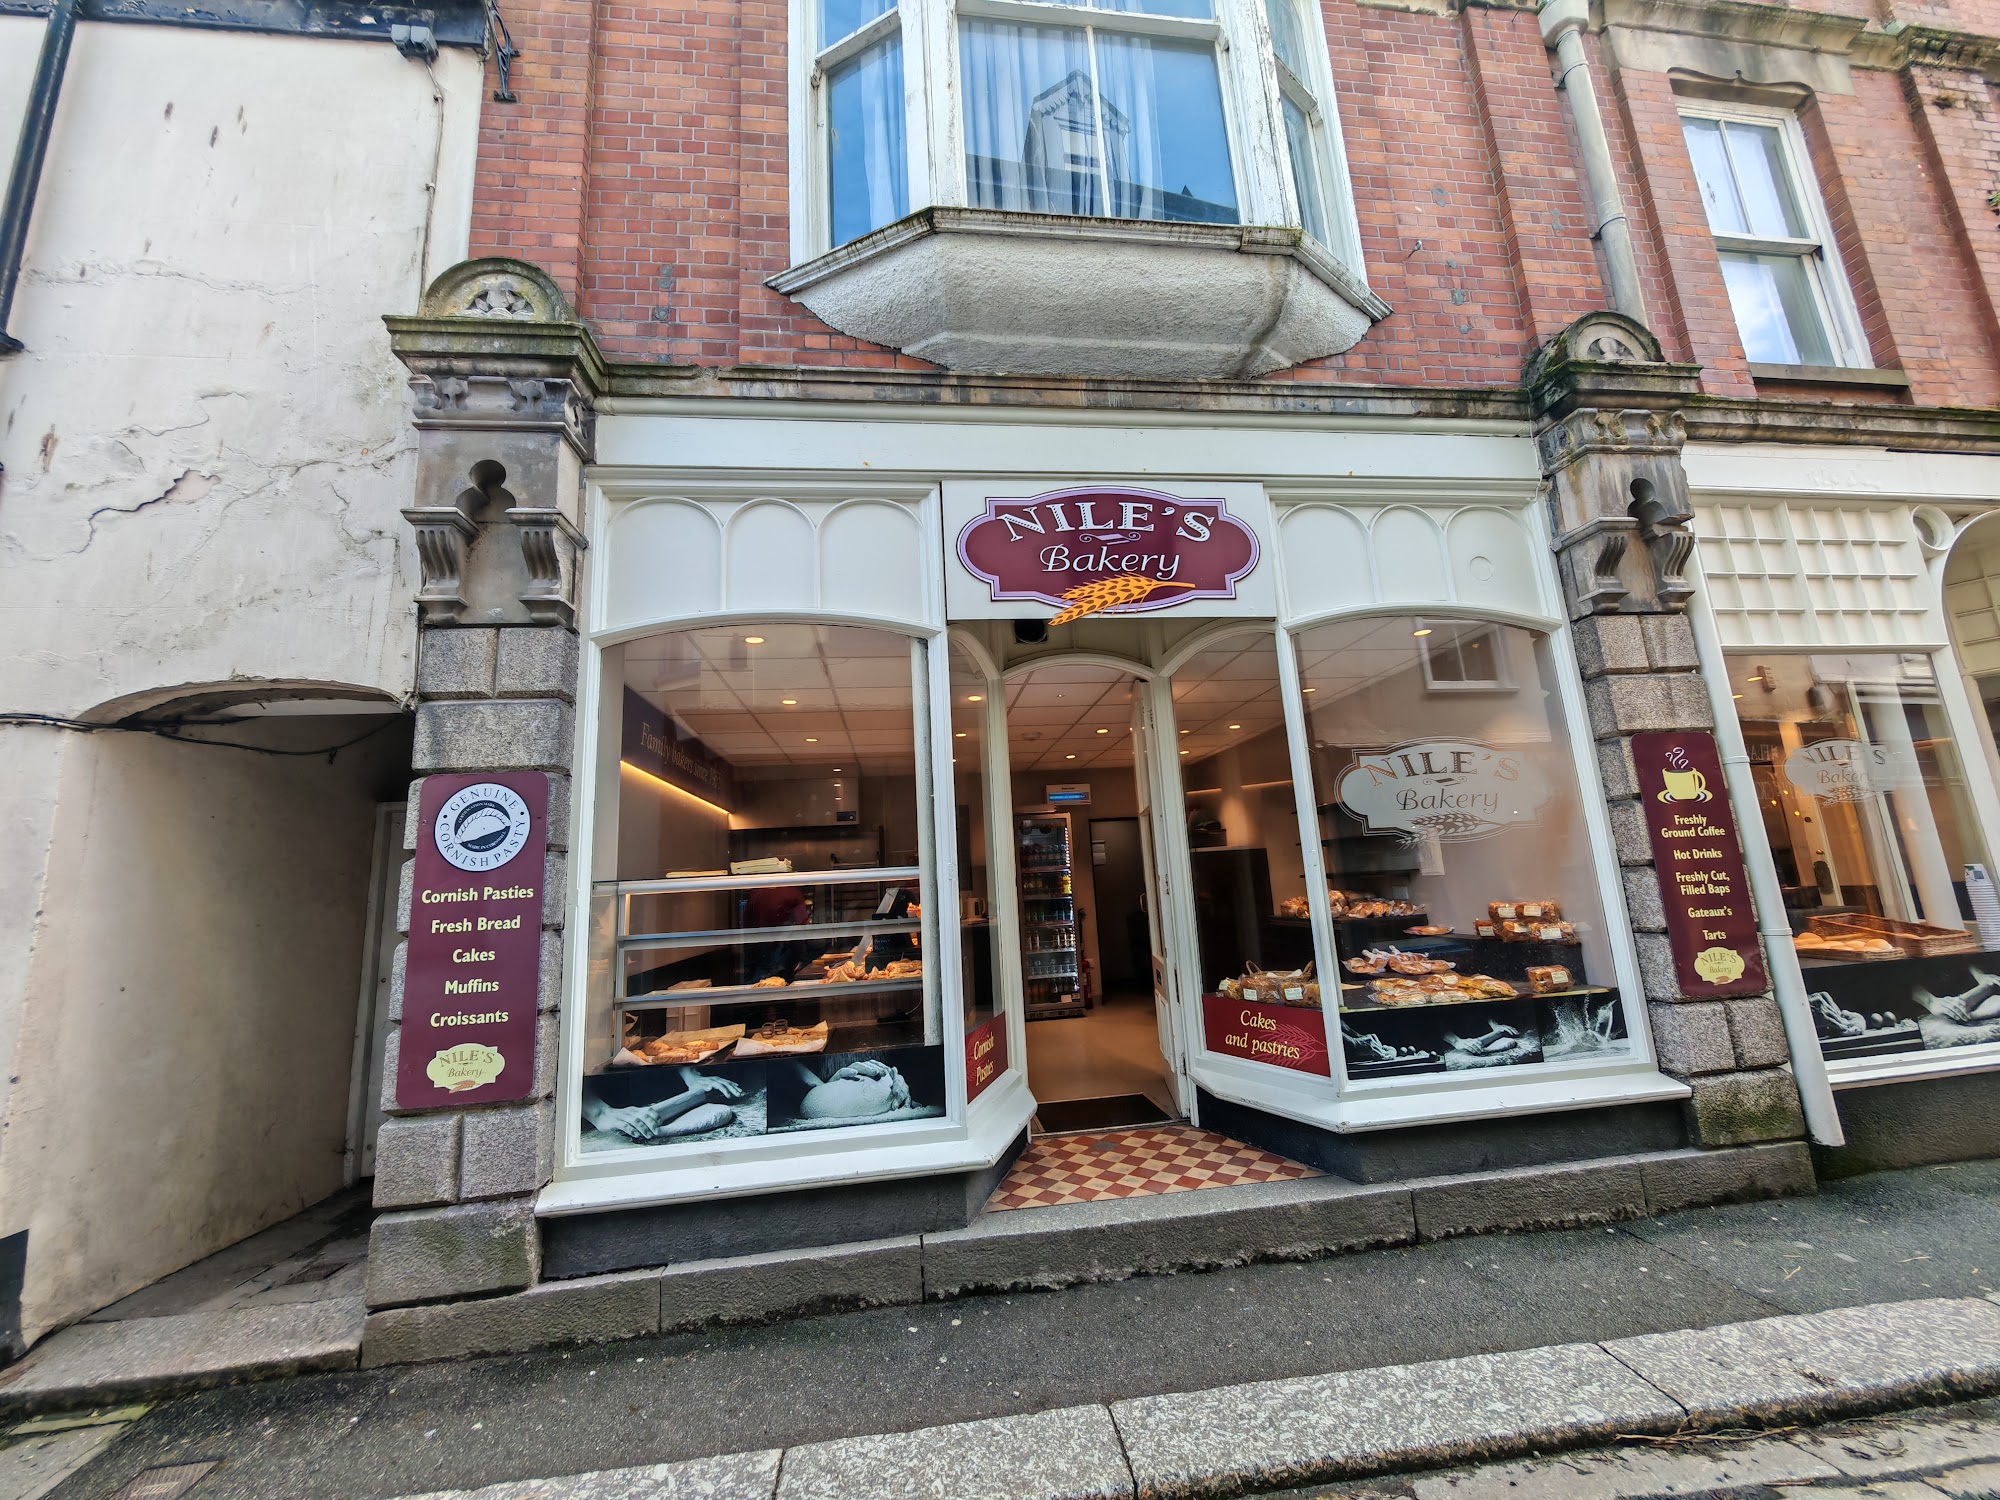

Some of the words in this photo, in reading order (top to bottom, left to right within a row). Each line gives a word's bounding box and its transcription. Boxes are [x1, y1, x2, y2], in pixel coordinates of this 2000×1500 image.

[996, 501, 1215, 543] NILE'S
[1039, 543, 1180, 580] Bakery
[641, 722, 670, 764] Family
[672, 742, 692, 773] bakers
[1802, 745, 1886, 765] NILES
[1362, 750, 1521, 787] NILE'S
[450, 788, 519, 811] GENUINE
[1395, 788, 1499, 814] Bakery
[1674, 814, 1707, 827] Freshly
[1661, 826, 1696, 838] Ground
[1697, 826, 1726, 837] Coffee
[440, 823, 489, 867] CORNISH
[493, 820, 526, 863] PASTY
[1673, 849, 1691, 860] Hot
[1692, 848, 1723, 860] Drinks
[1676, 871, 1709, 884] Freshly
[1710, 871, 1730, 882] Cut,
[421, 888, 478, 904] Cornish
[483, 885, 535, 901] Pasties
[1680, 884, 1706, 896] Filled
[1707, 883, 1730, 897] Baps
[1687, 906, 1733, 918] Gateaux's
[431, 918, 473, 933] Fresh
[477, 915, 521, 931] Bread
[1702, 929, 1727, 941] Tarts
[452, 948, 496, 963] Cakes
[1700, 952, 1737, 965] NILE'S
[1708, 965, 1732, 975] Bakery
[444, 978, 500, 995] Muffins
[429, 1009, 509, 1028] Croissants
[1240, 1010, 1276, 1030] Cakes
[1225, 1033, 1248, 1048] and
[1251, 1038, 1300, 1059] pastries
[438, 1050, 496, 1067] NILE'S
[447, 1066, 483, 1079] Bakery
